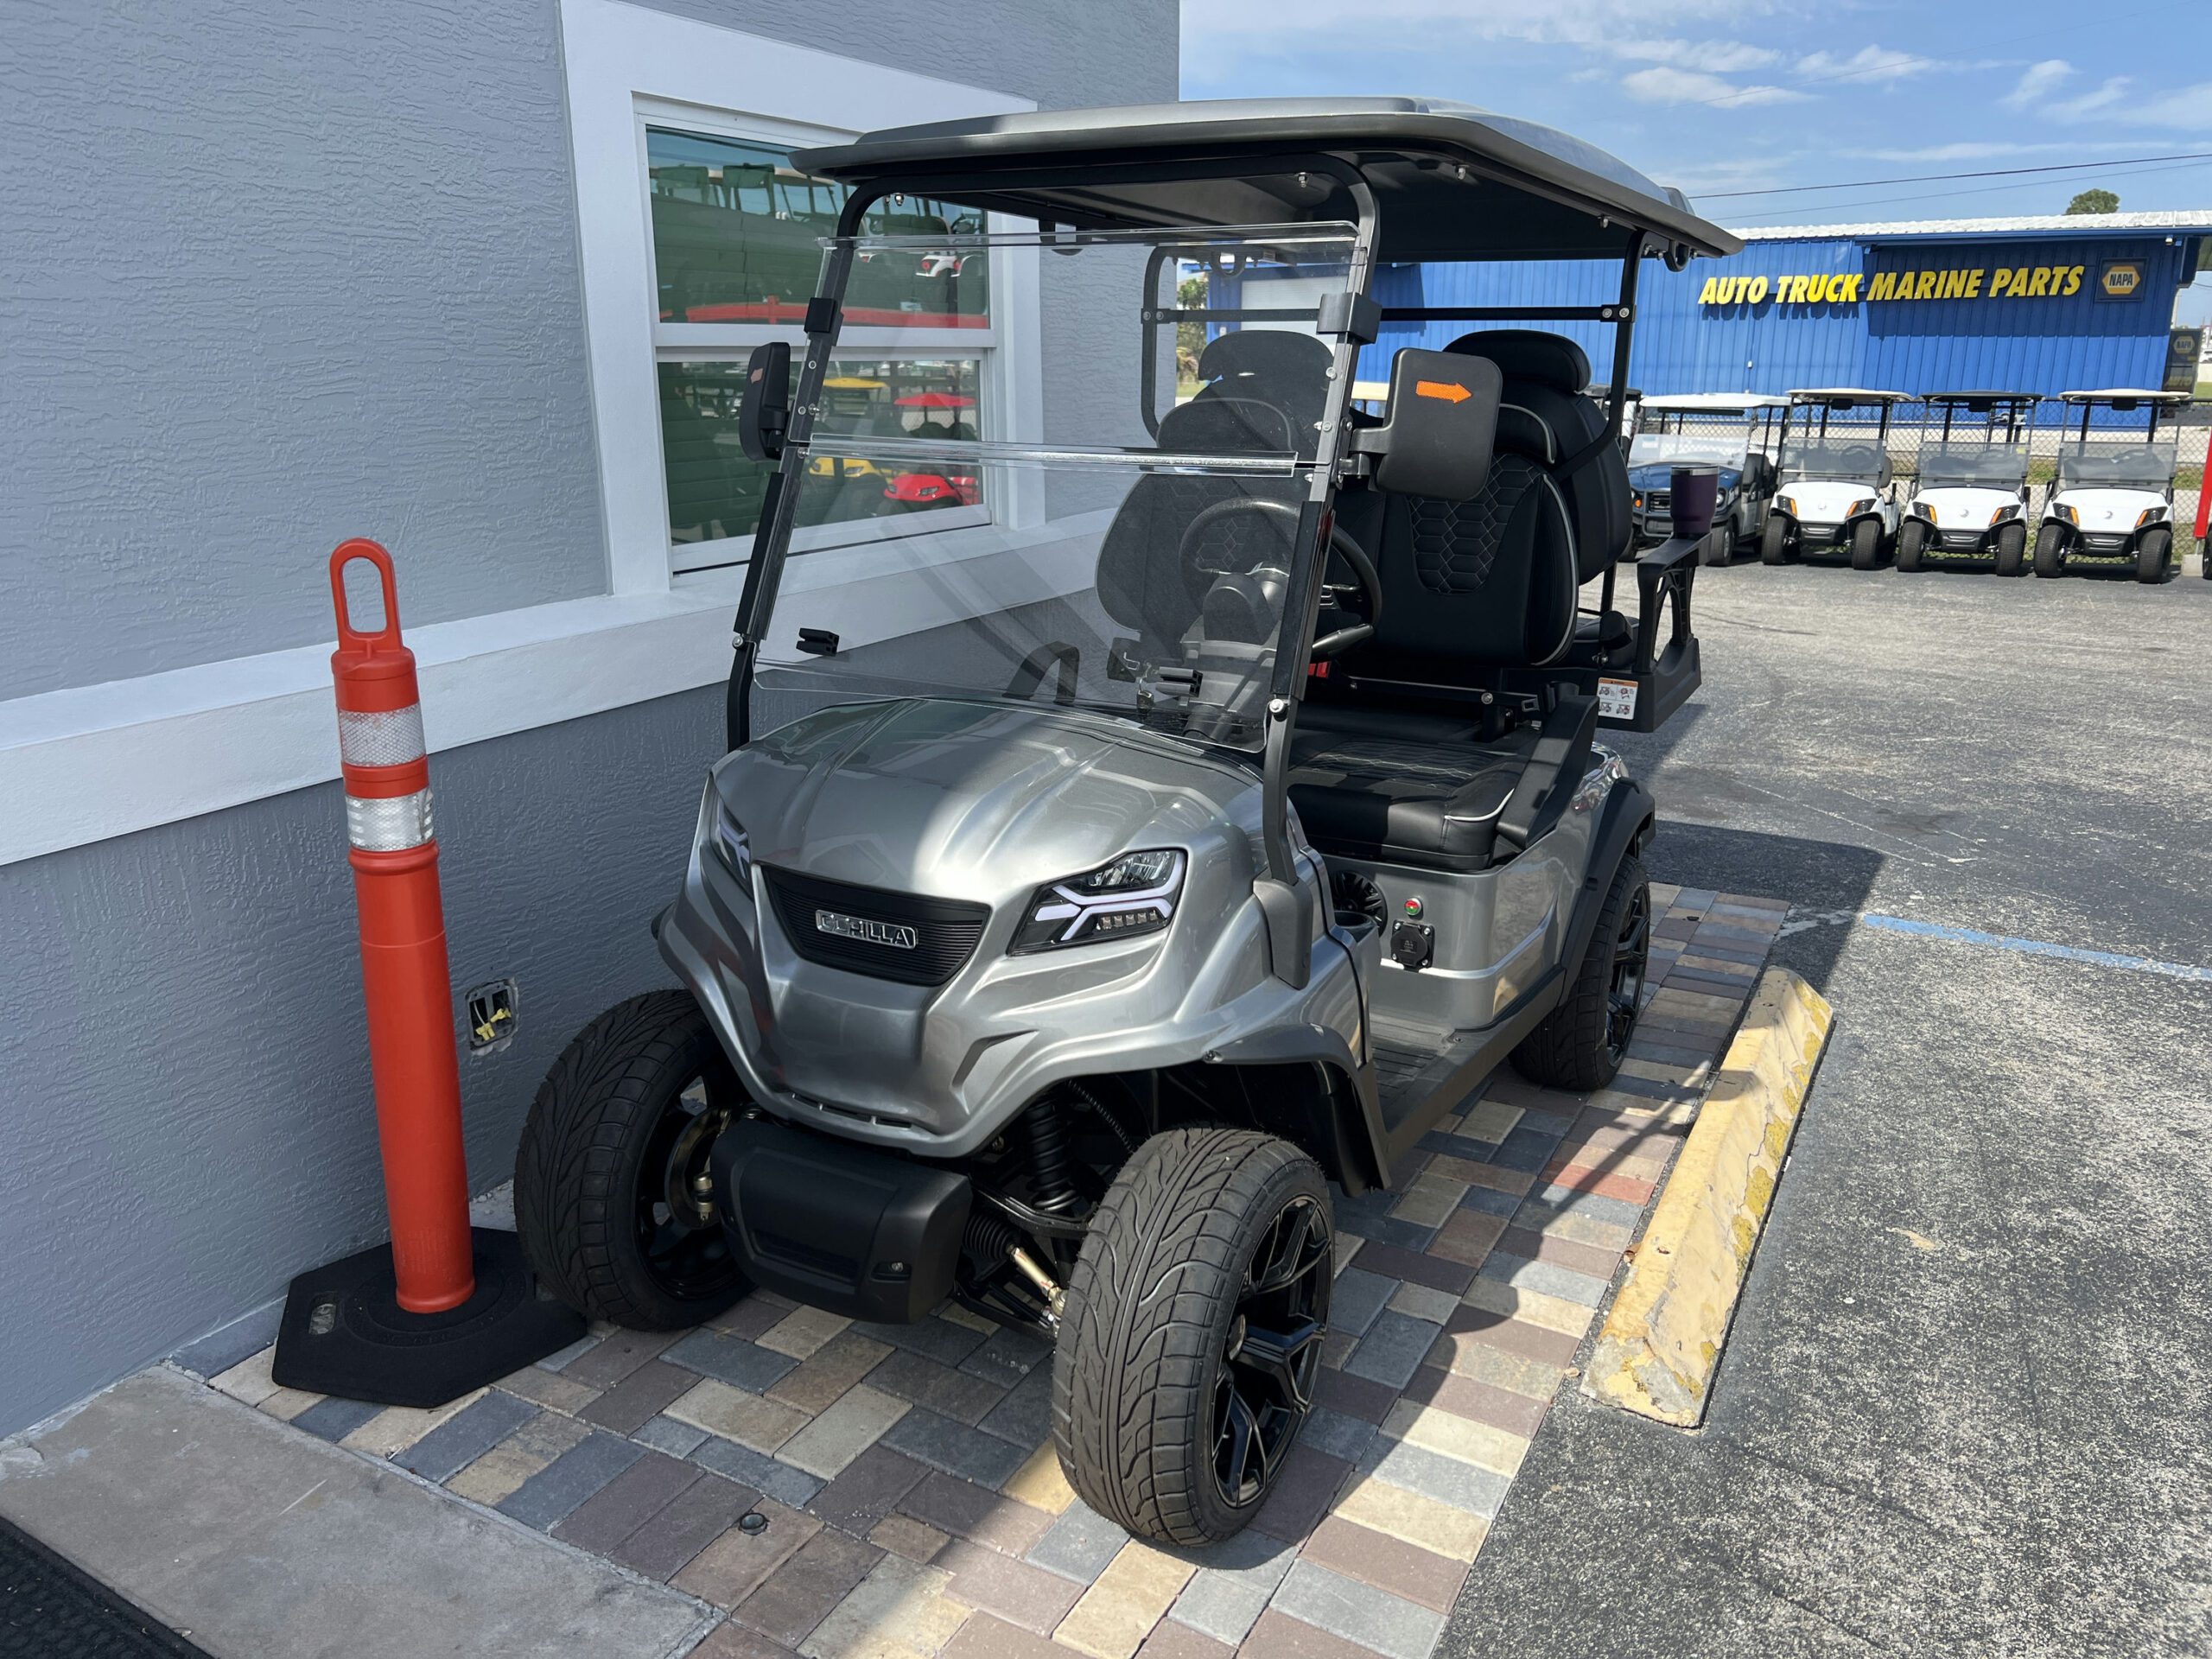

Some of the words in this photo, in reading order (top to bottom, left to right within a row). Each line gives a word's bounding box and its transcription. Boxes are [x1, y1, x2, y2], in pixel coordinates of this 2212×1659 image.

[1698, 276, 1769, 304] AUTO
[1775, 274, 1863, 303] TRUCK
[1866, 269, 1985, 301] MARINE
[1988, 264, 2085, 297] PARTS
[2109, 273, 2133, 286] NAPA
[817, 910, 914, 948] GORILLA
